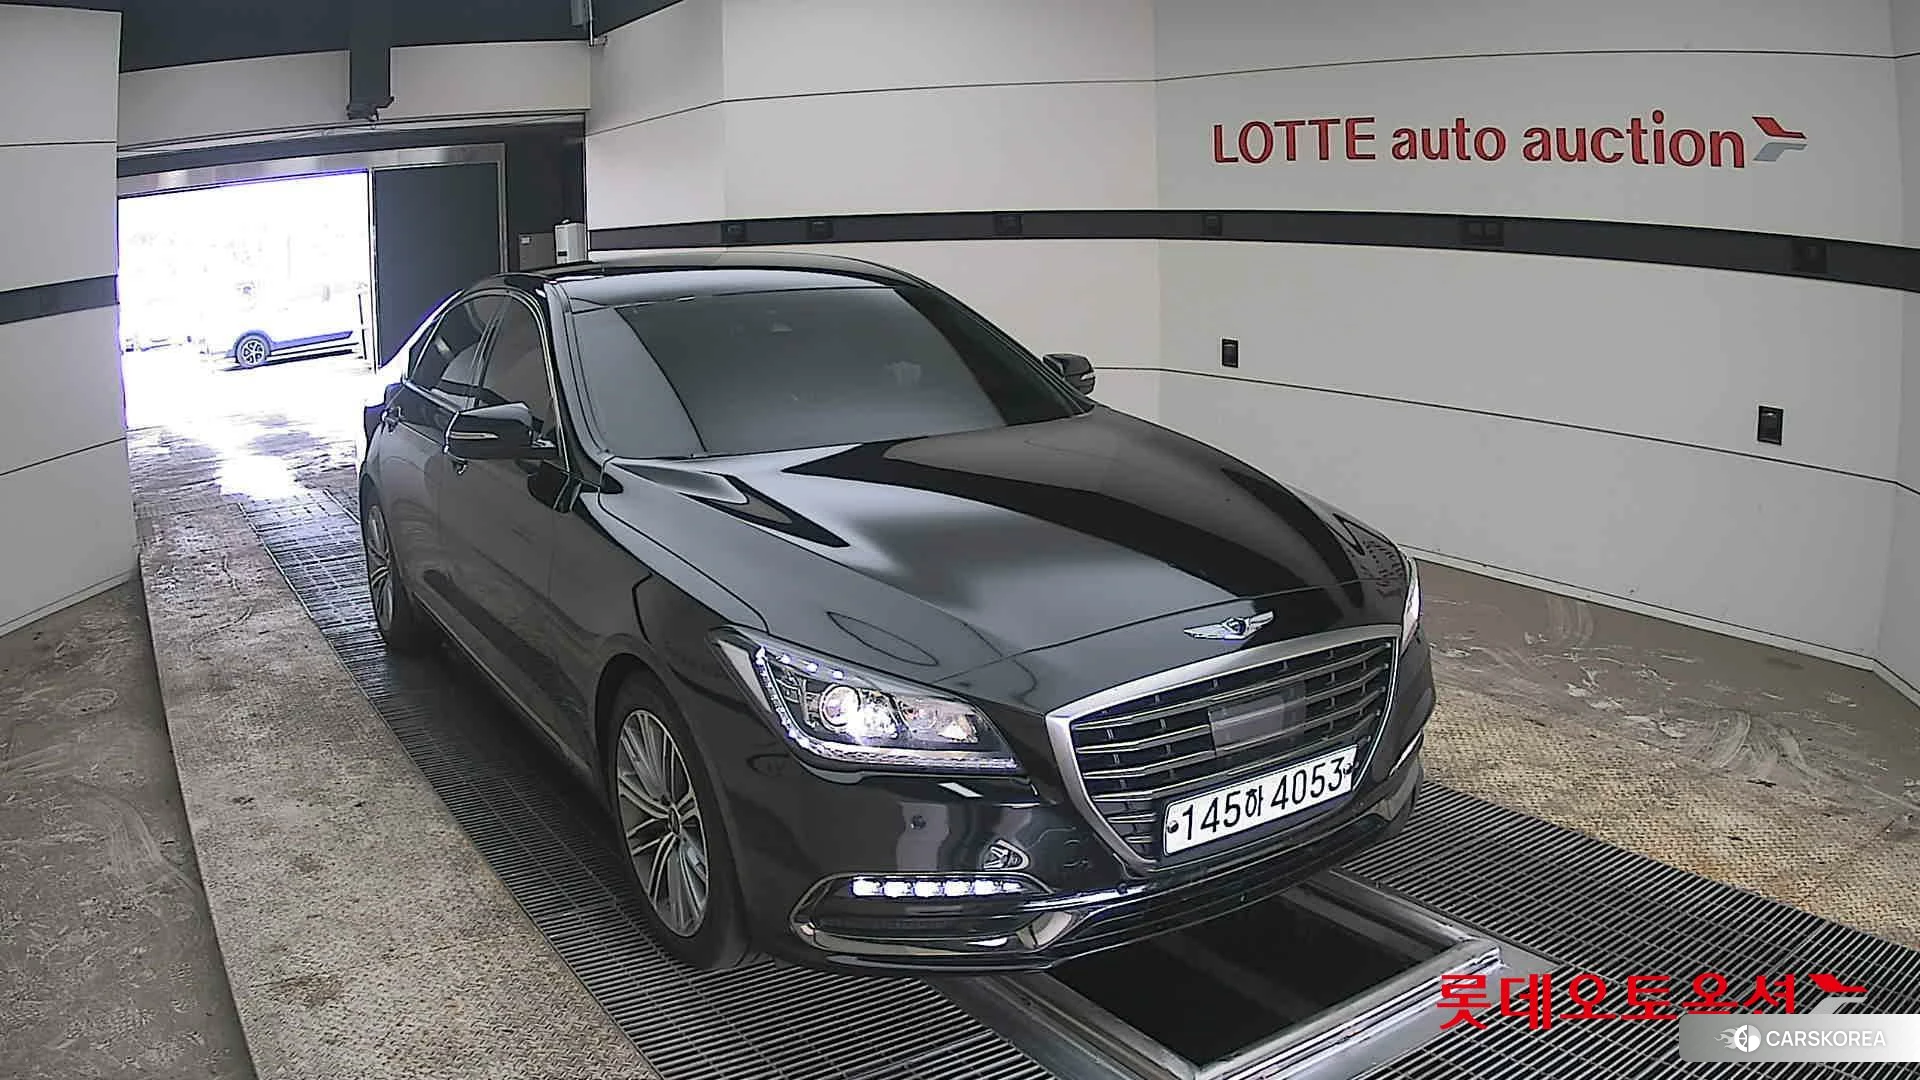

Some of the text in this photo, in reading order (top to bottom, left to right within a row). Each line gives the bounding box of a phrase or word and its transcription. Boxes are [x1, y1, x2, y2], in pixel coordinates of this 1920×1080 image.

[1213, 110, 1745, 168] LOTTE auto auction
[1182, 757, 1345, 841] 145하 4053
